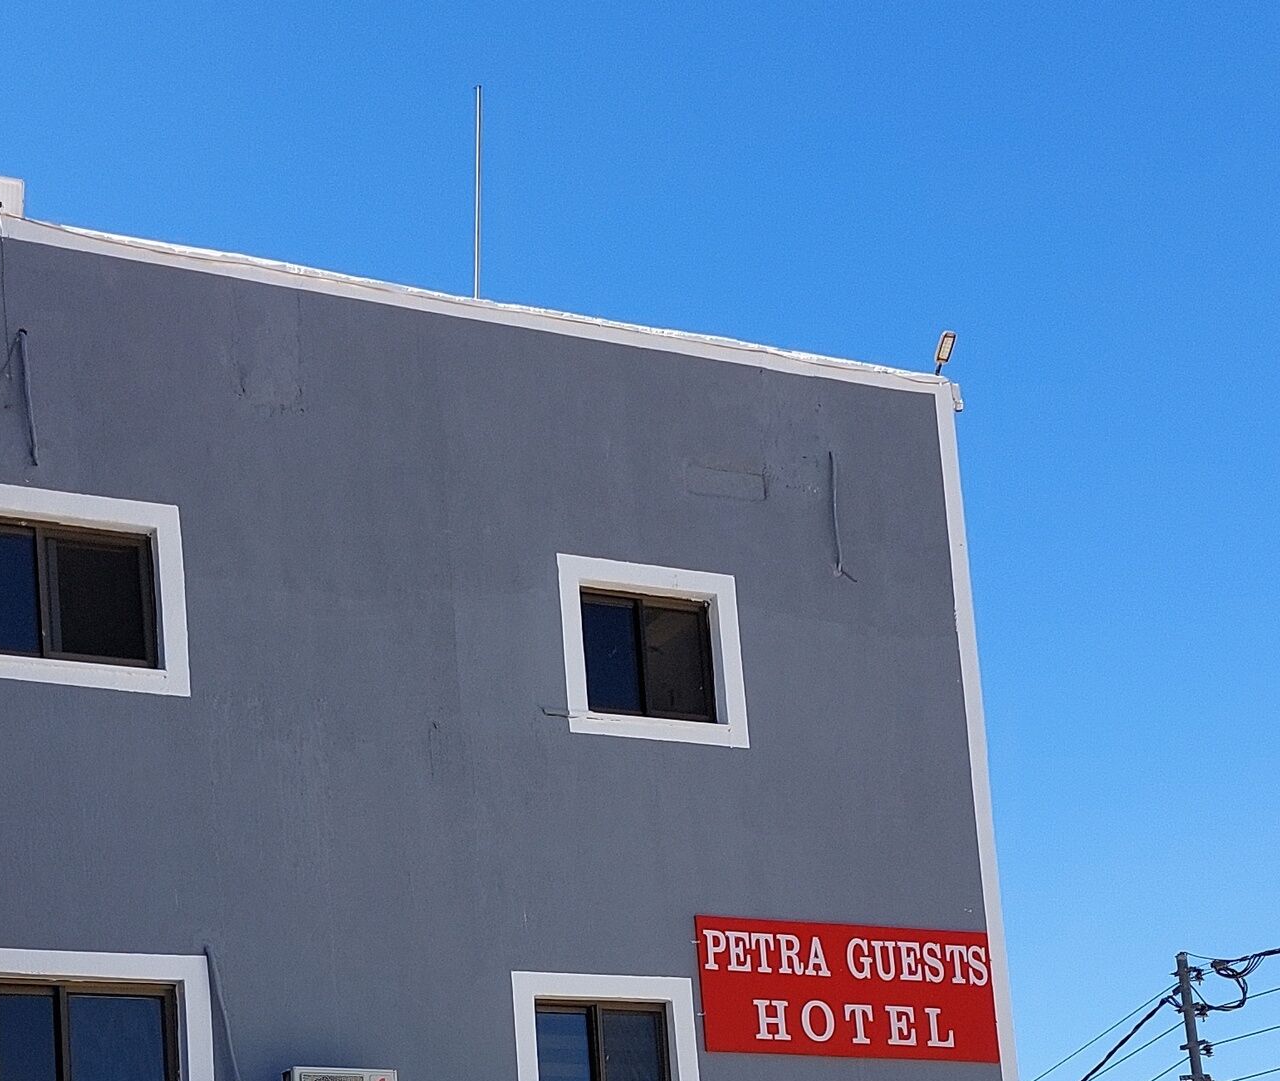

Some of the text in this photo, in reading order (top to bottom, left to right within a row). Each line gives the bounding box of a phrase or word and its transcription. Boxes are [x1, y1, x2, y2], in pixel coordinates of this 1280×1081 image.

[702, 929, 989, 987] PETRA GUESTS
[753, 999, 955, 1048] HOTEL
